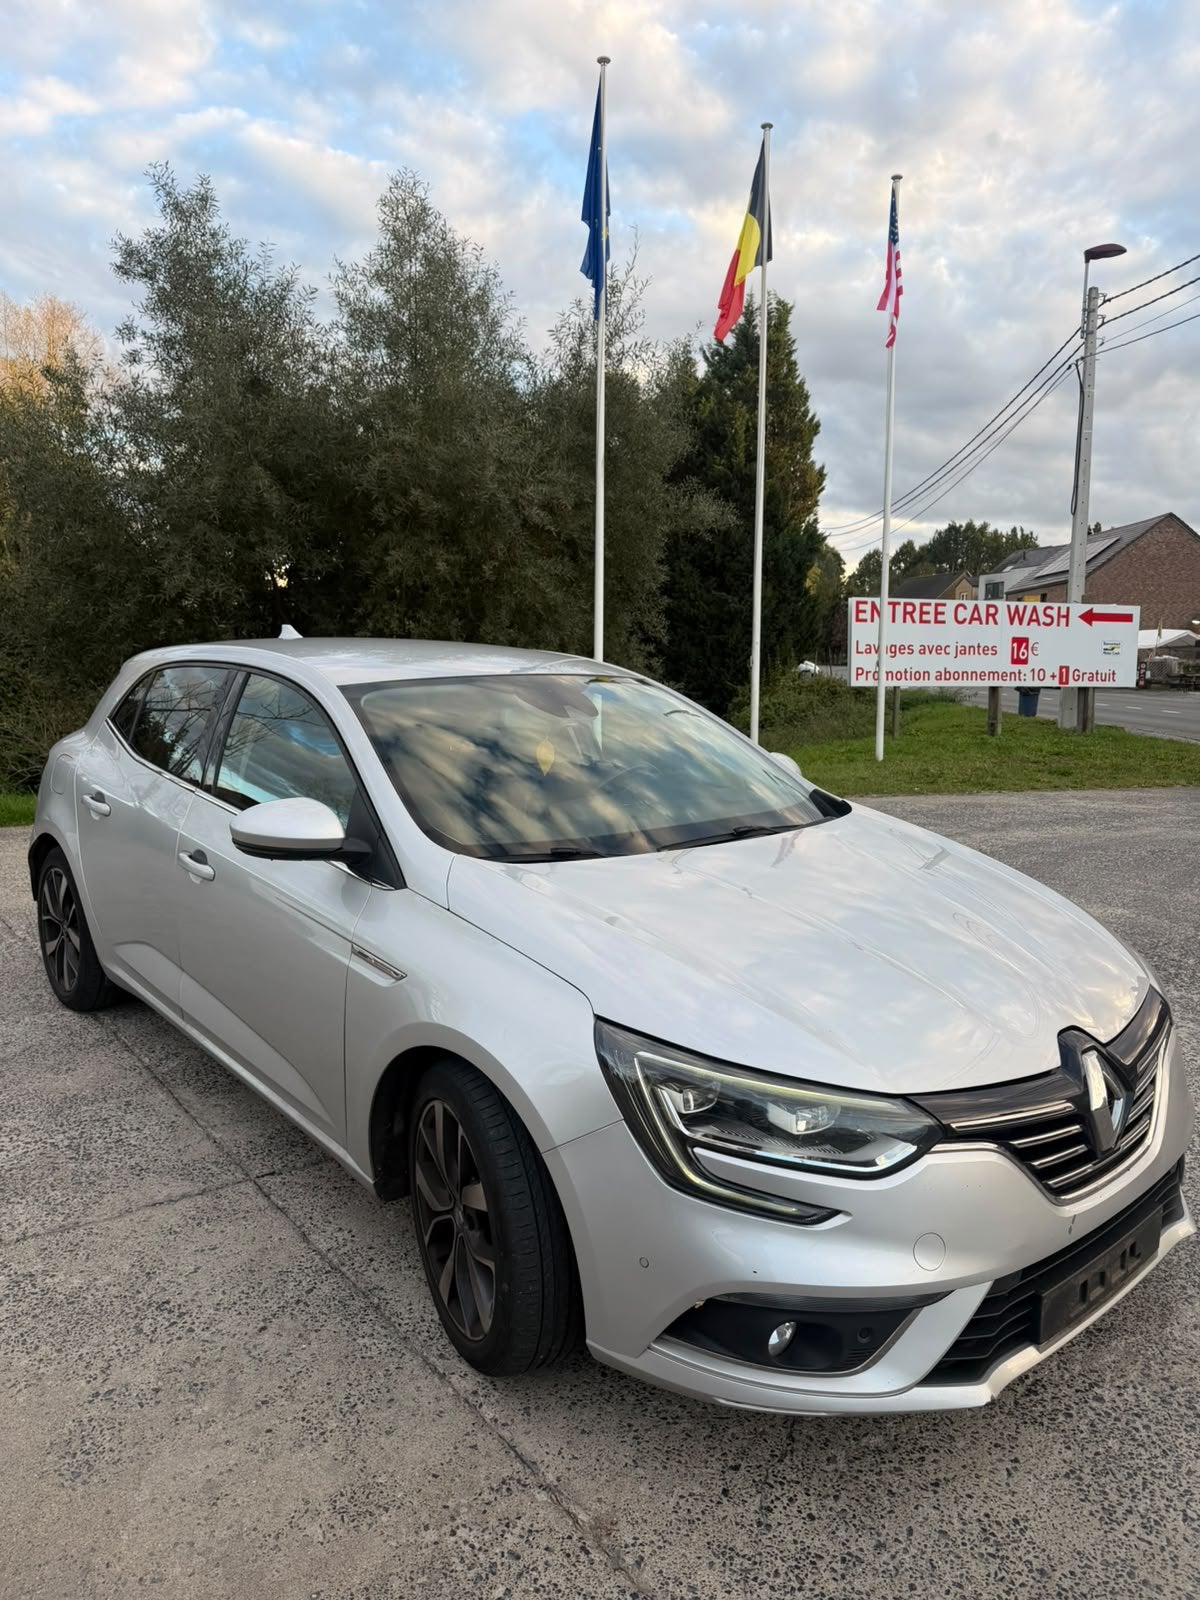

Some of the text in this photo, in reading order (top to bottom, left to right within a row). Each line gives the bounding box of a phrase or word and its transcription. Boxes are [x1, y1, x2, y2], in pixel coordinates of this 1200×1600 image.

[855, 601, 1070, 627] ENTREE CAR WASH
[855, 640, 915, 658] Lavges
[918, 644, 951, 655] avec
[953, 641, 998, 659] jantes
[935, 667, 1027, 682] abonnement:
[1030, 668, 1046, 682] 10
[1072, 669, 1116, 682] Gratuit
